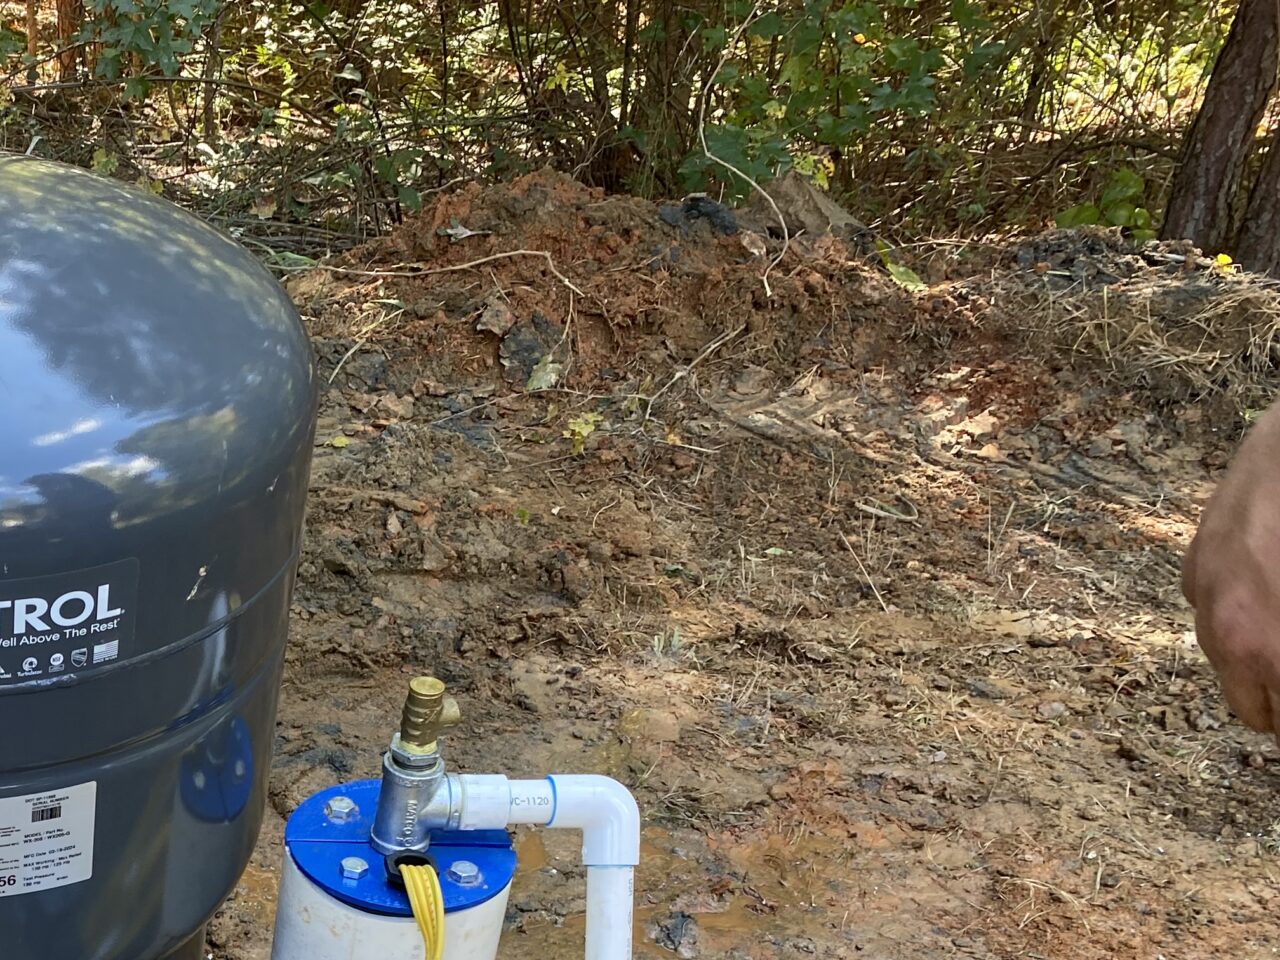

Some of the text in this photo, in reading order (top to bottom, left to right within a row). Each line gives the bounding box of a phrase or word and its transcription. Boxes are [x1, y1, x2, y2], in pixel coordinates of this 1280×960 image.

[19, 632, 60, 646] Above
[64, 628, 87, 639] The
[90, 620, 118, 634] Rest
